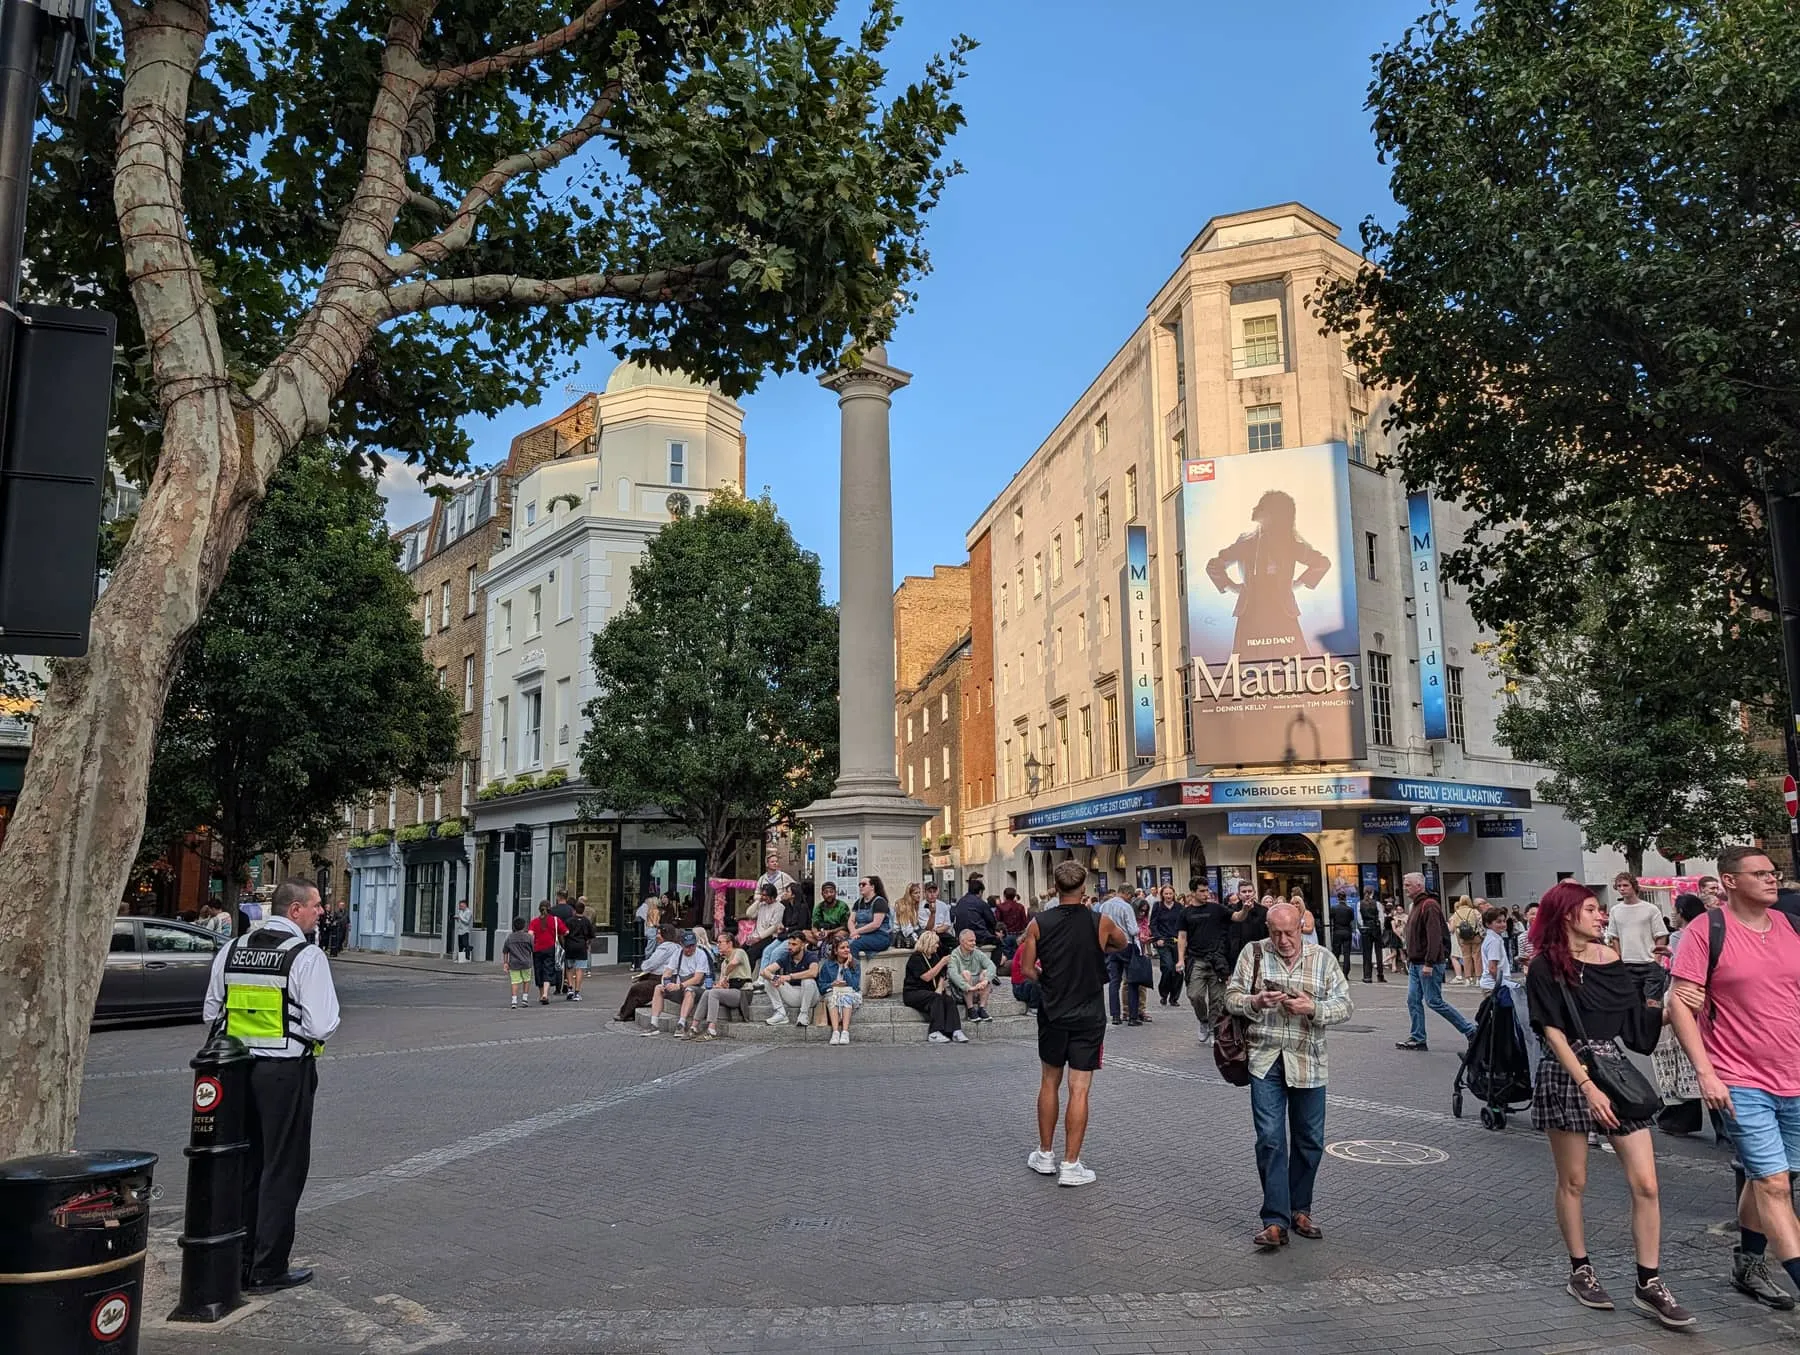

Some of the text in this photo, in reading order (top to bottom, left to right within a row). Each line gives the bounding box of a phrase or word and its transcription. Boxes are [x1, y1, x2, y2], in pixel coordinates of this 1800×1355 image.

[1189, 463, 1213, 475] RSC
[1413, 532, 1439, 687] Matilda
[1131, 565, 1149, 706] Matilda
[1192, 652, 1361, 702] Matilda
[1216, 704, 1243, 713] DENNIS
[1244, 703, 1267, 712] KELLY
[1321, 699, 1354, 707] MINCHIN
[1182, 784, 1210, 796] RSC
[1224, 784, 1356, 797] CAMBRIDGE THEATRE
[1075, 806, 1092, 817] MUSICAL
[1092, 804, 1100, 815] OF
[1100, 803, 1108, 813] THE
[1108, 800, 1119, 811] 21ST
[1262, 816, 1275, 828] 15
[1275, 819, 1295, 827] Years
[232, 950, 283, 967] SECURITY
